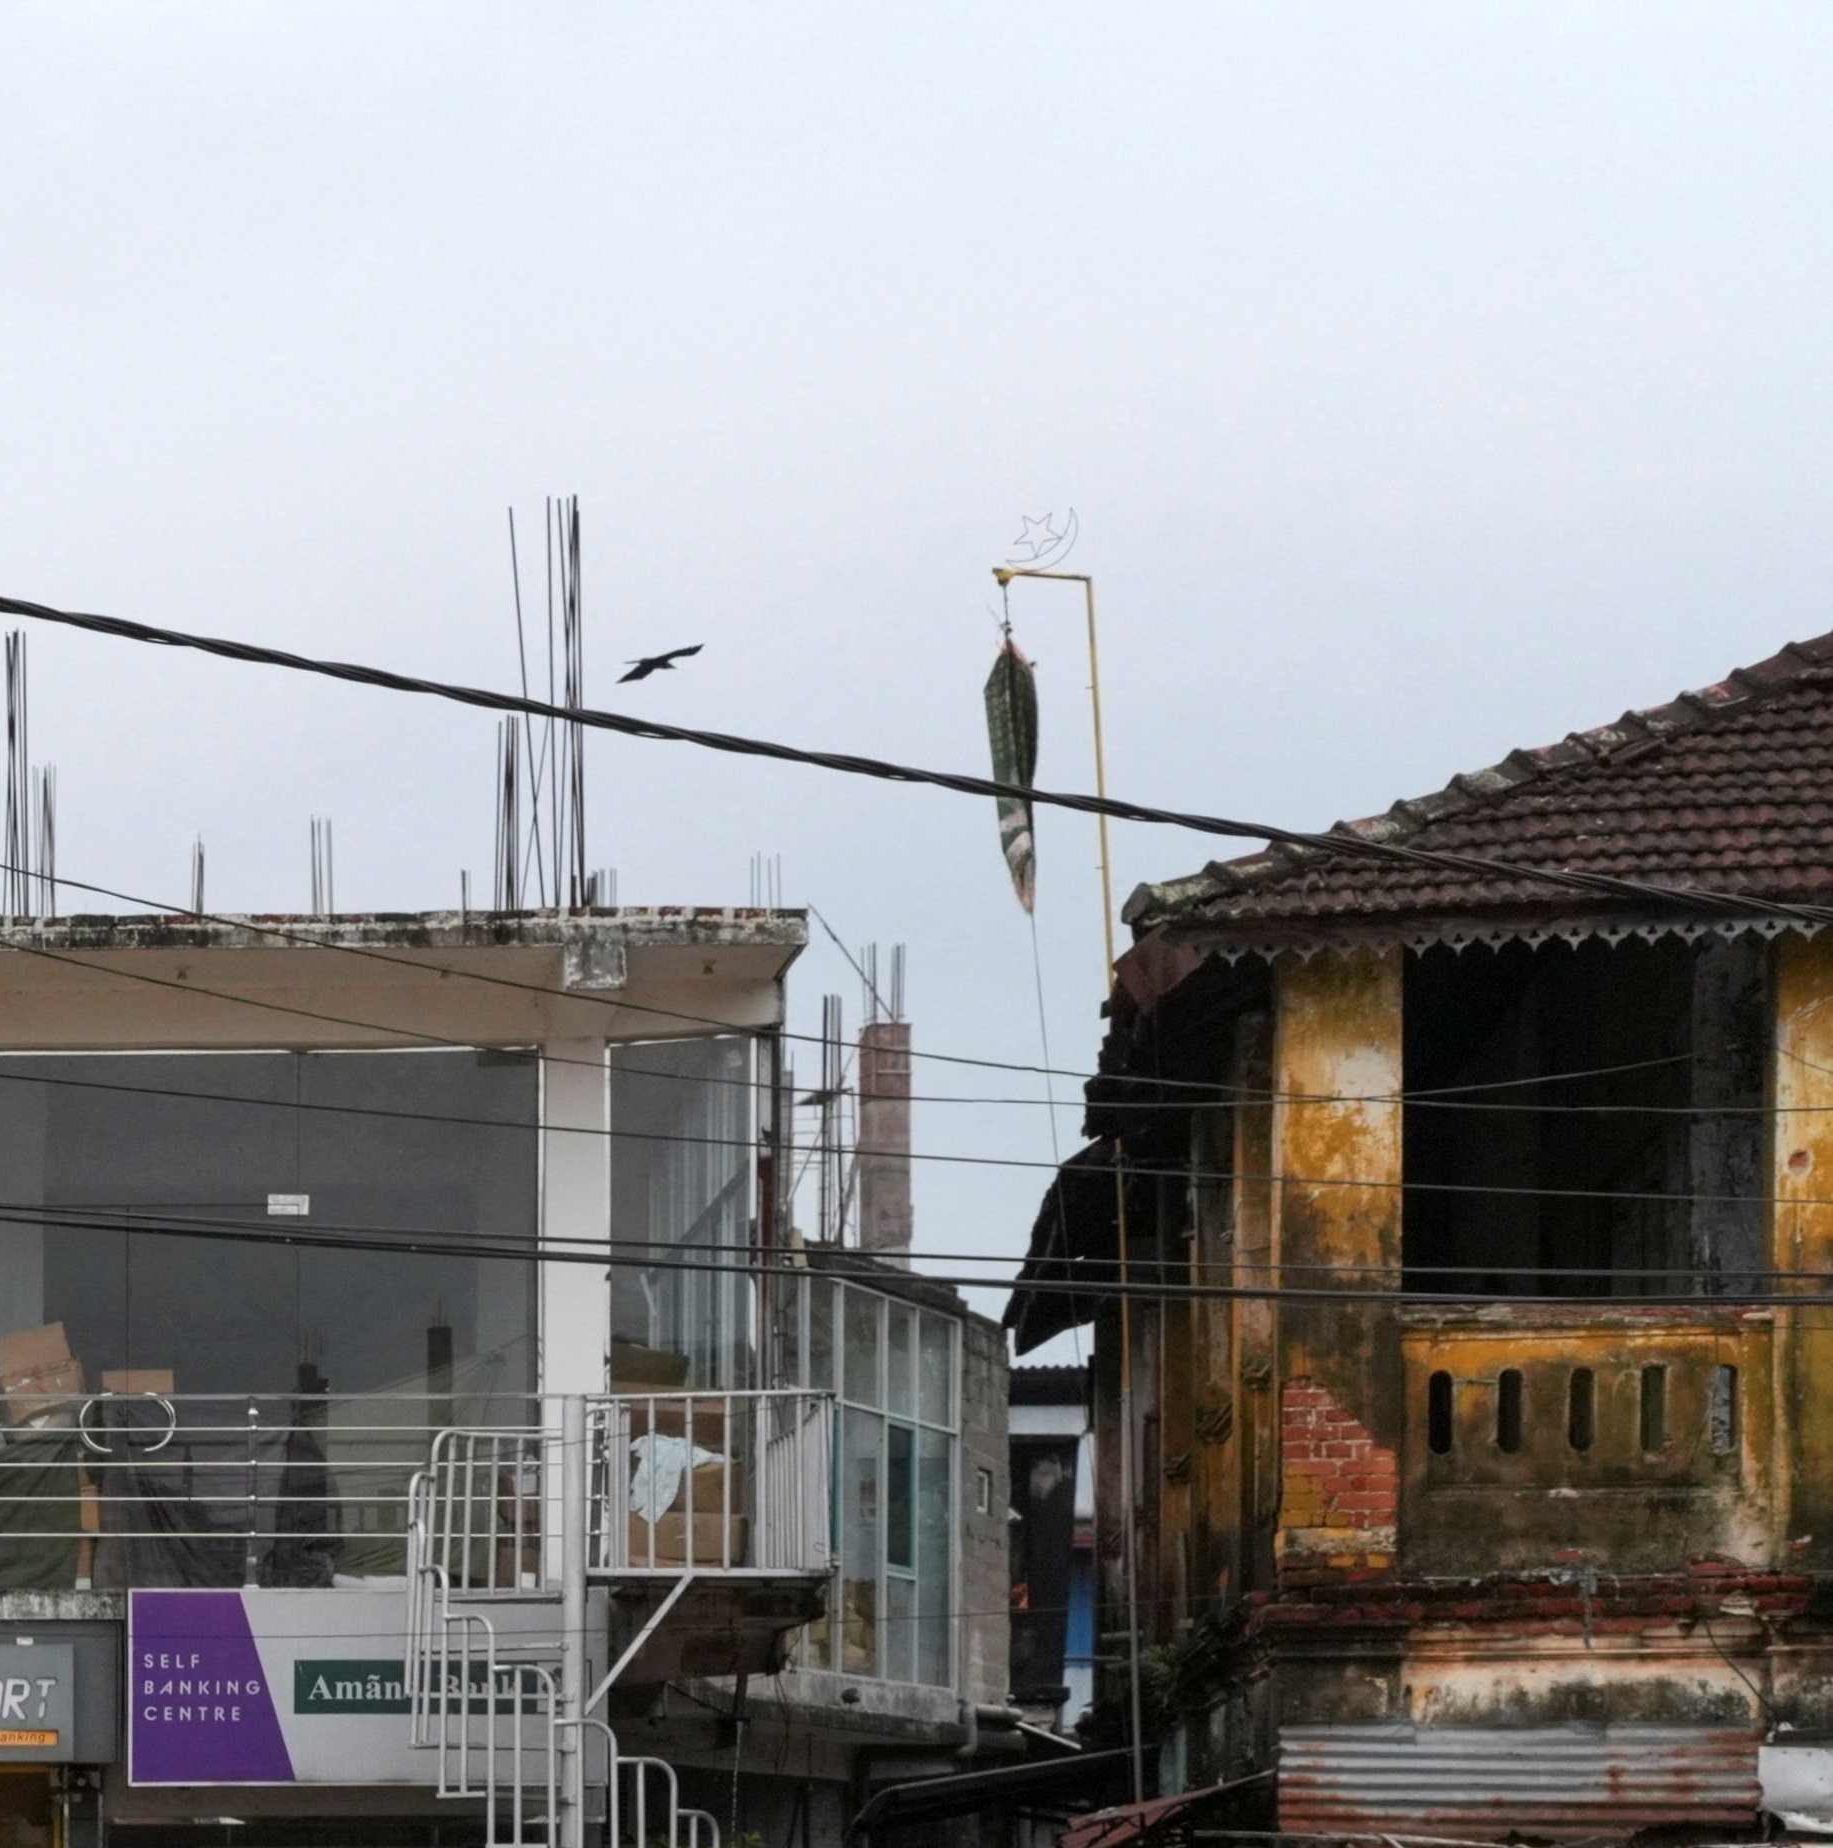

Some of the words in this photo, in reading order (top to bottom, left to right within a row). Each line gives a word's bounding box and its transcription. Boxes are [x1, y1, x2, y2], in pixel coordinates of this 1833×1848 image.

[143, 1653, 201, 1669] SELF
[143, 1680, 261, 1695] BANKING
[143, 1706, 241, 1721] CENTRE
